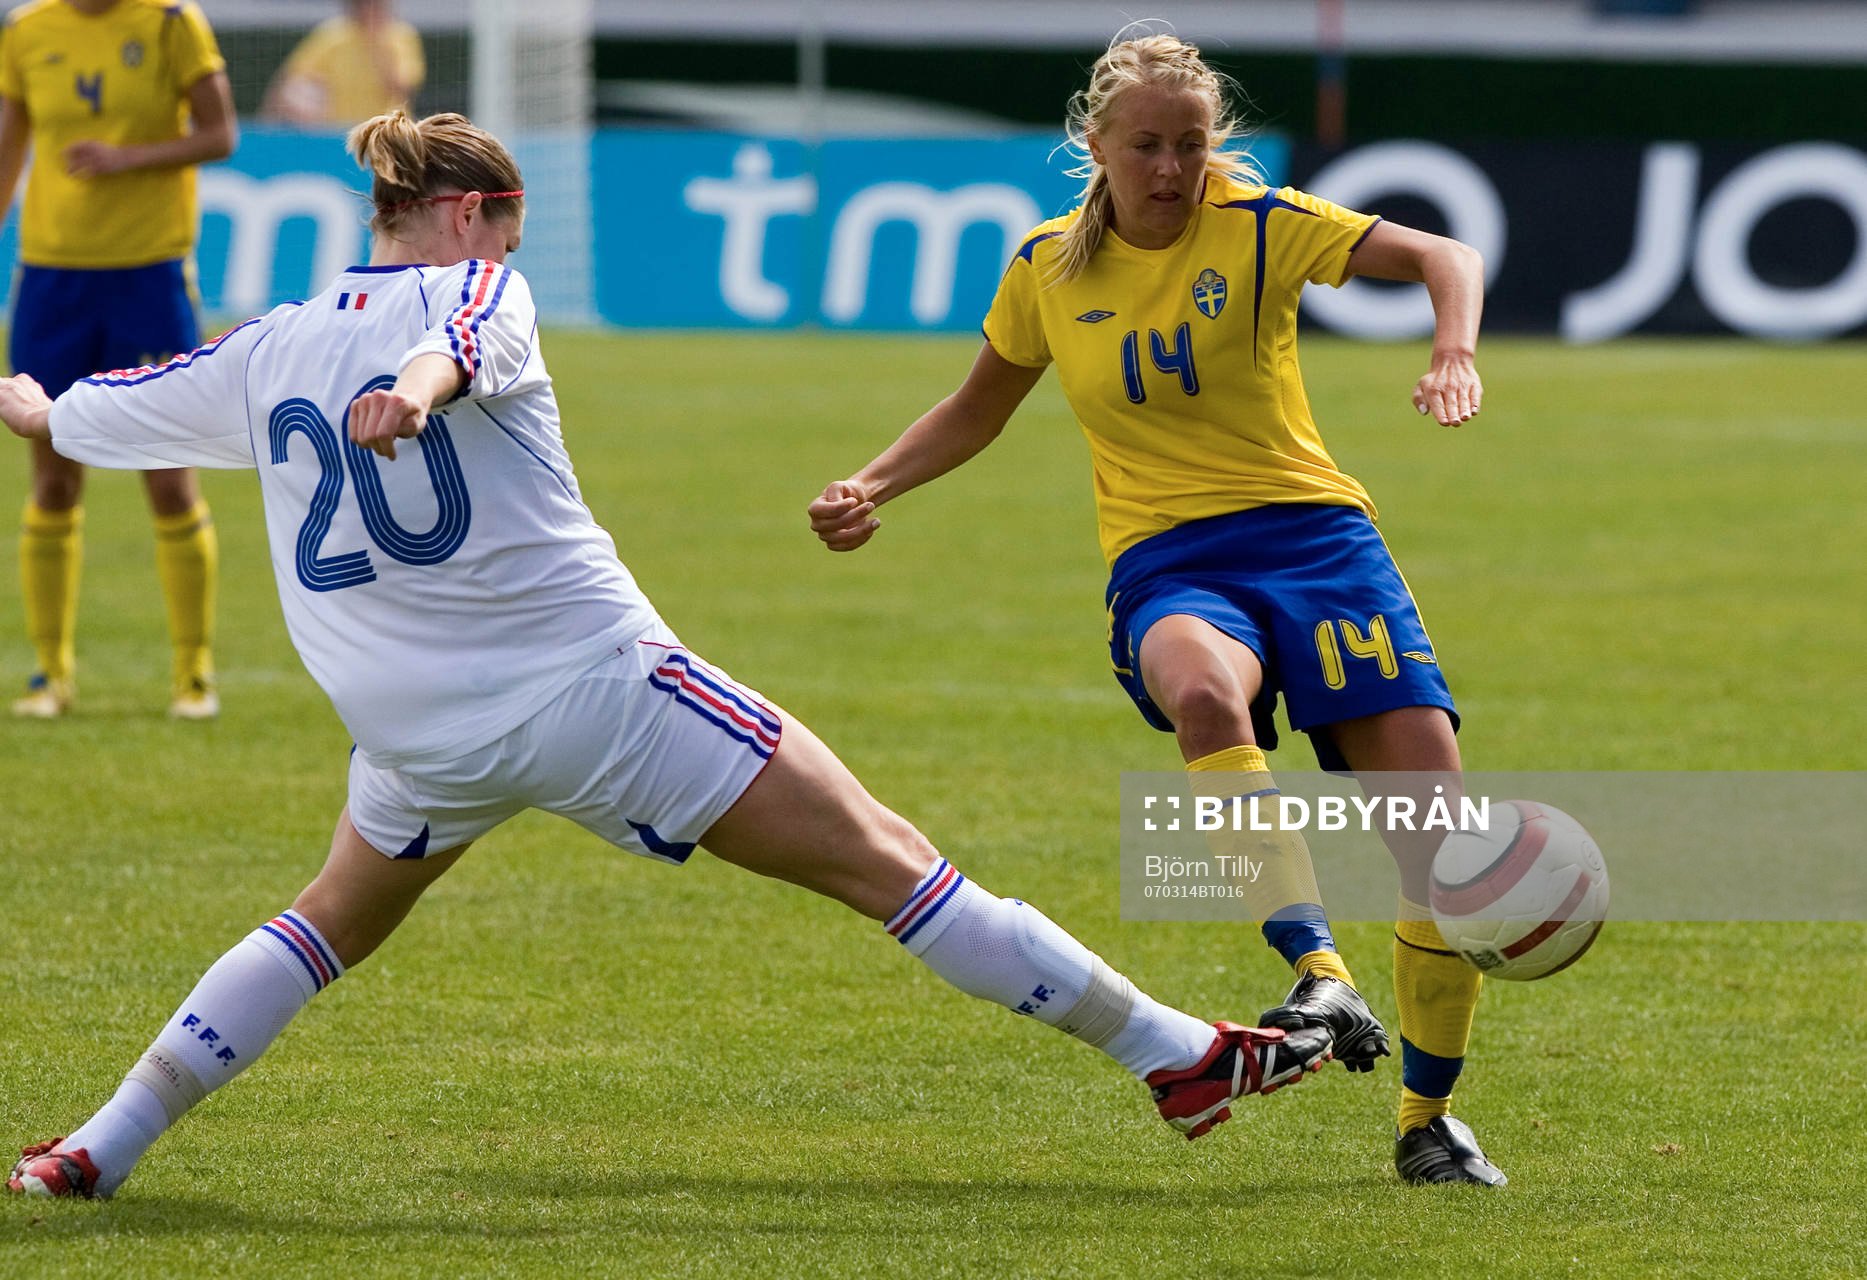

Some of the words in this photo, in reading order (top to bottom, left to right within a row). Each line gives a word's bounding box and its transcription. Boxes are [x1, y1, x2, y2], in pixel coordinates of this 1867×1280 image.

[76, 72, 104, 114] 4
[683, 142, 1044, 322] tm
[1121, 322, 1200, 405] 14
[269, 375, 471, 592] 20
[1314, 614, 1399, 690] 14
